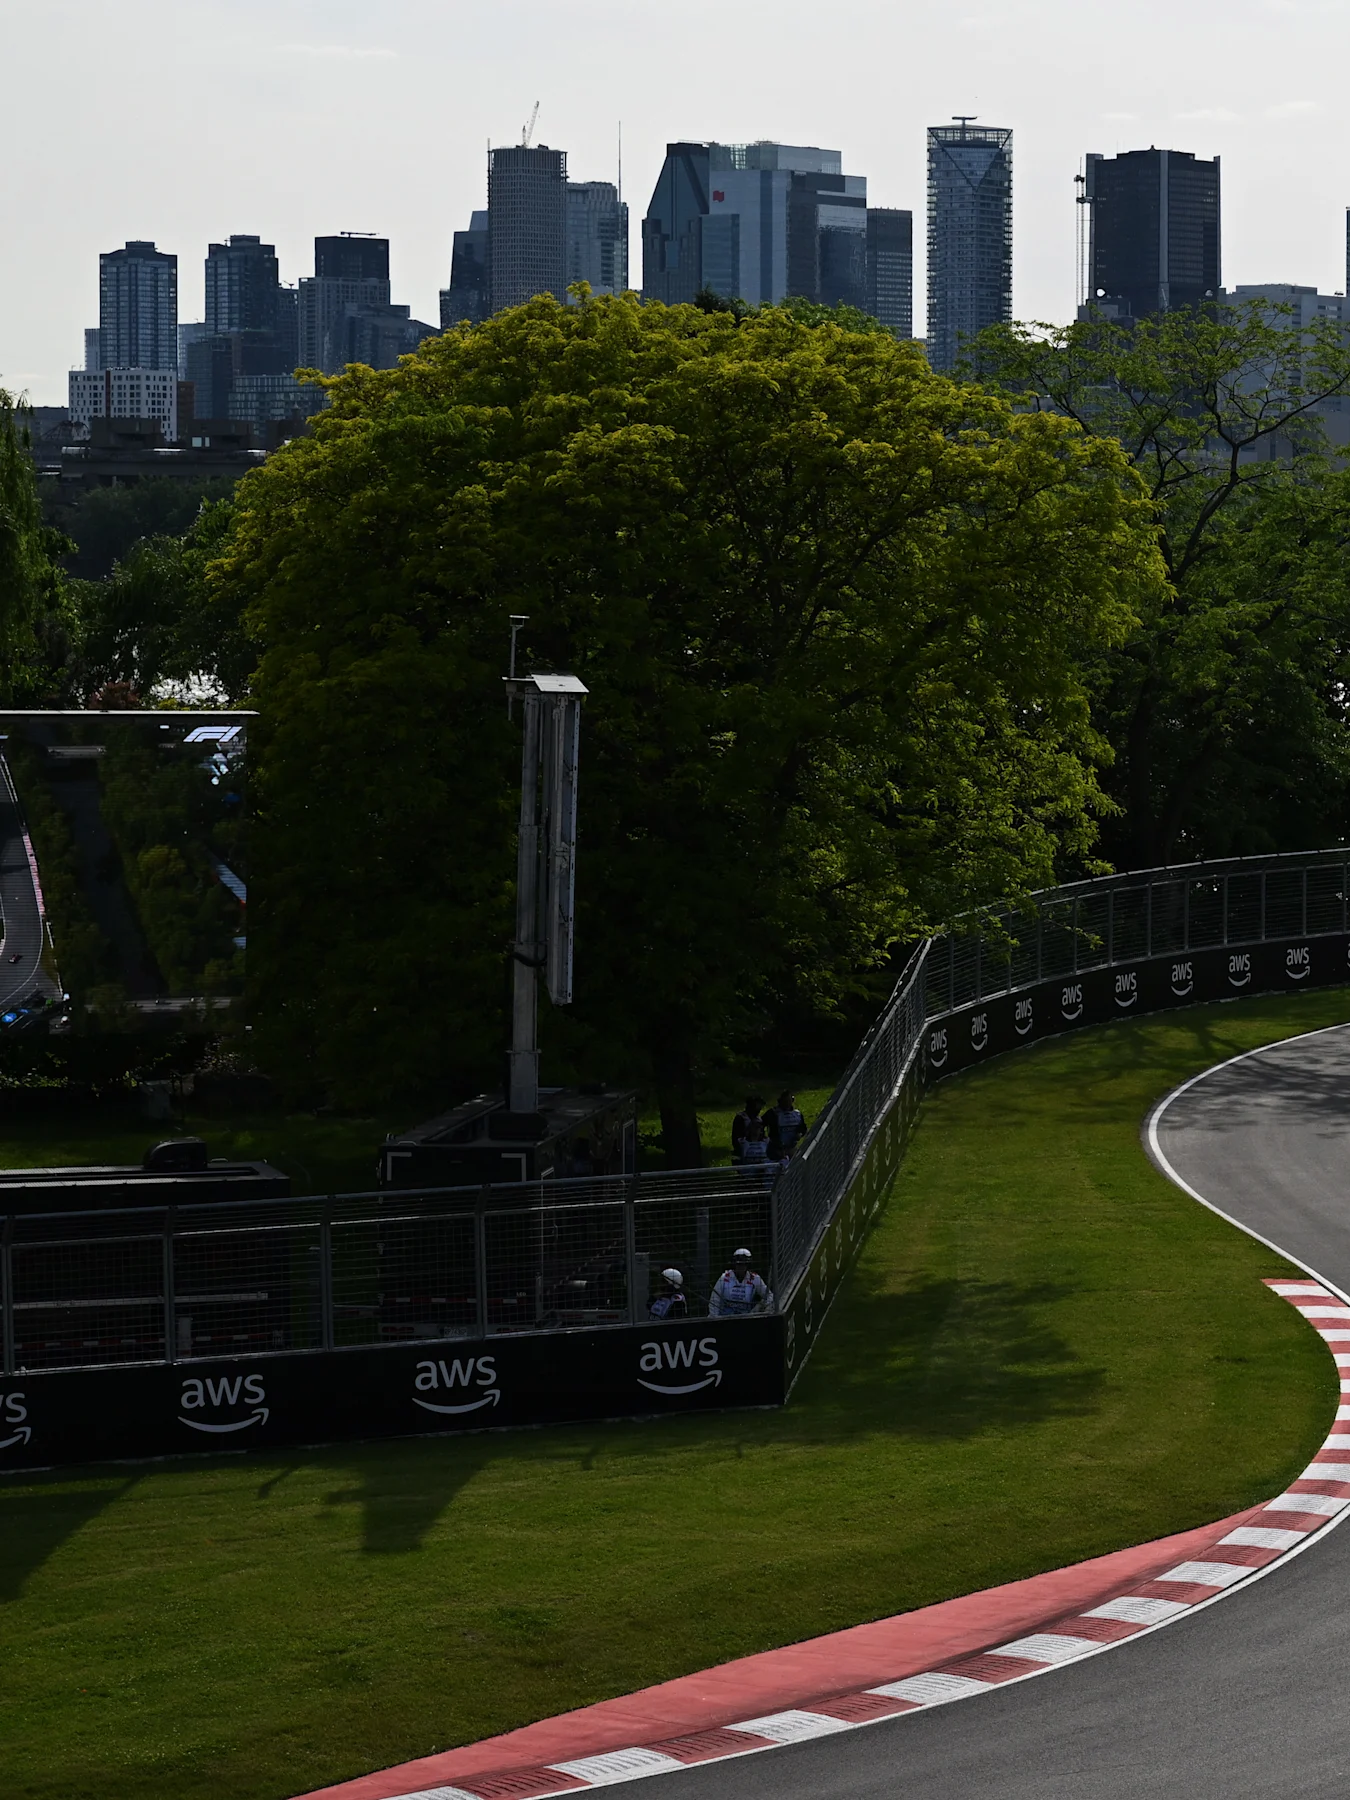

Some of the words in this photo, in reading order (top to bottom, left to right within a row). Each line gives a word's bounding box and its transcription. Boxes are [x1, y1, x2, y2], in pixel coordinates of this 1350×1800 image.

[1229, 954, 1252, 973] aws
[1286, 947, 1310, 966] aws
[1115, 971, 1137, 993] aws
[1171, 961, 1194, 982] aws
[1062, 983, 1083, 1006] aws
[1014, 997, 1033, 1021] aws
[971, 1013, 989, 1037] aws
[930, 1028, 948, 1052] aws
[639, 1337, 719, 1372] aws
[415, 1356, 497, 1391] aws
[181, 1374, 266, 1410] aws
